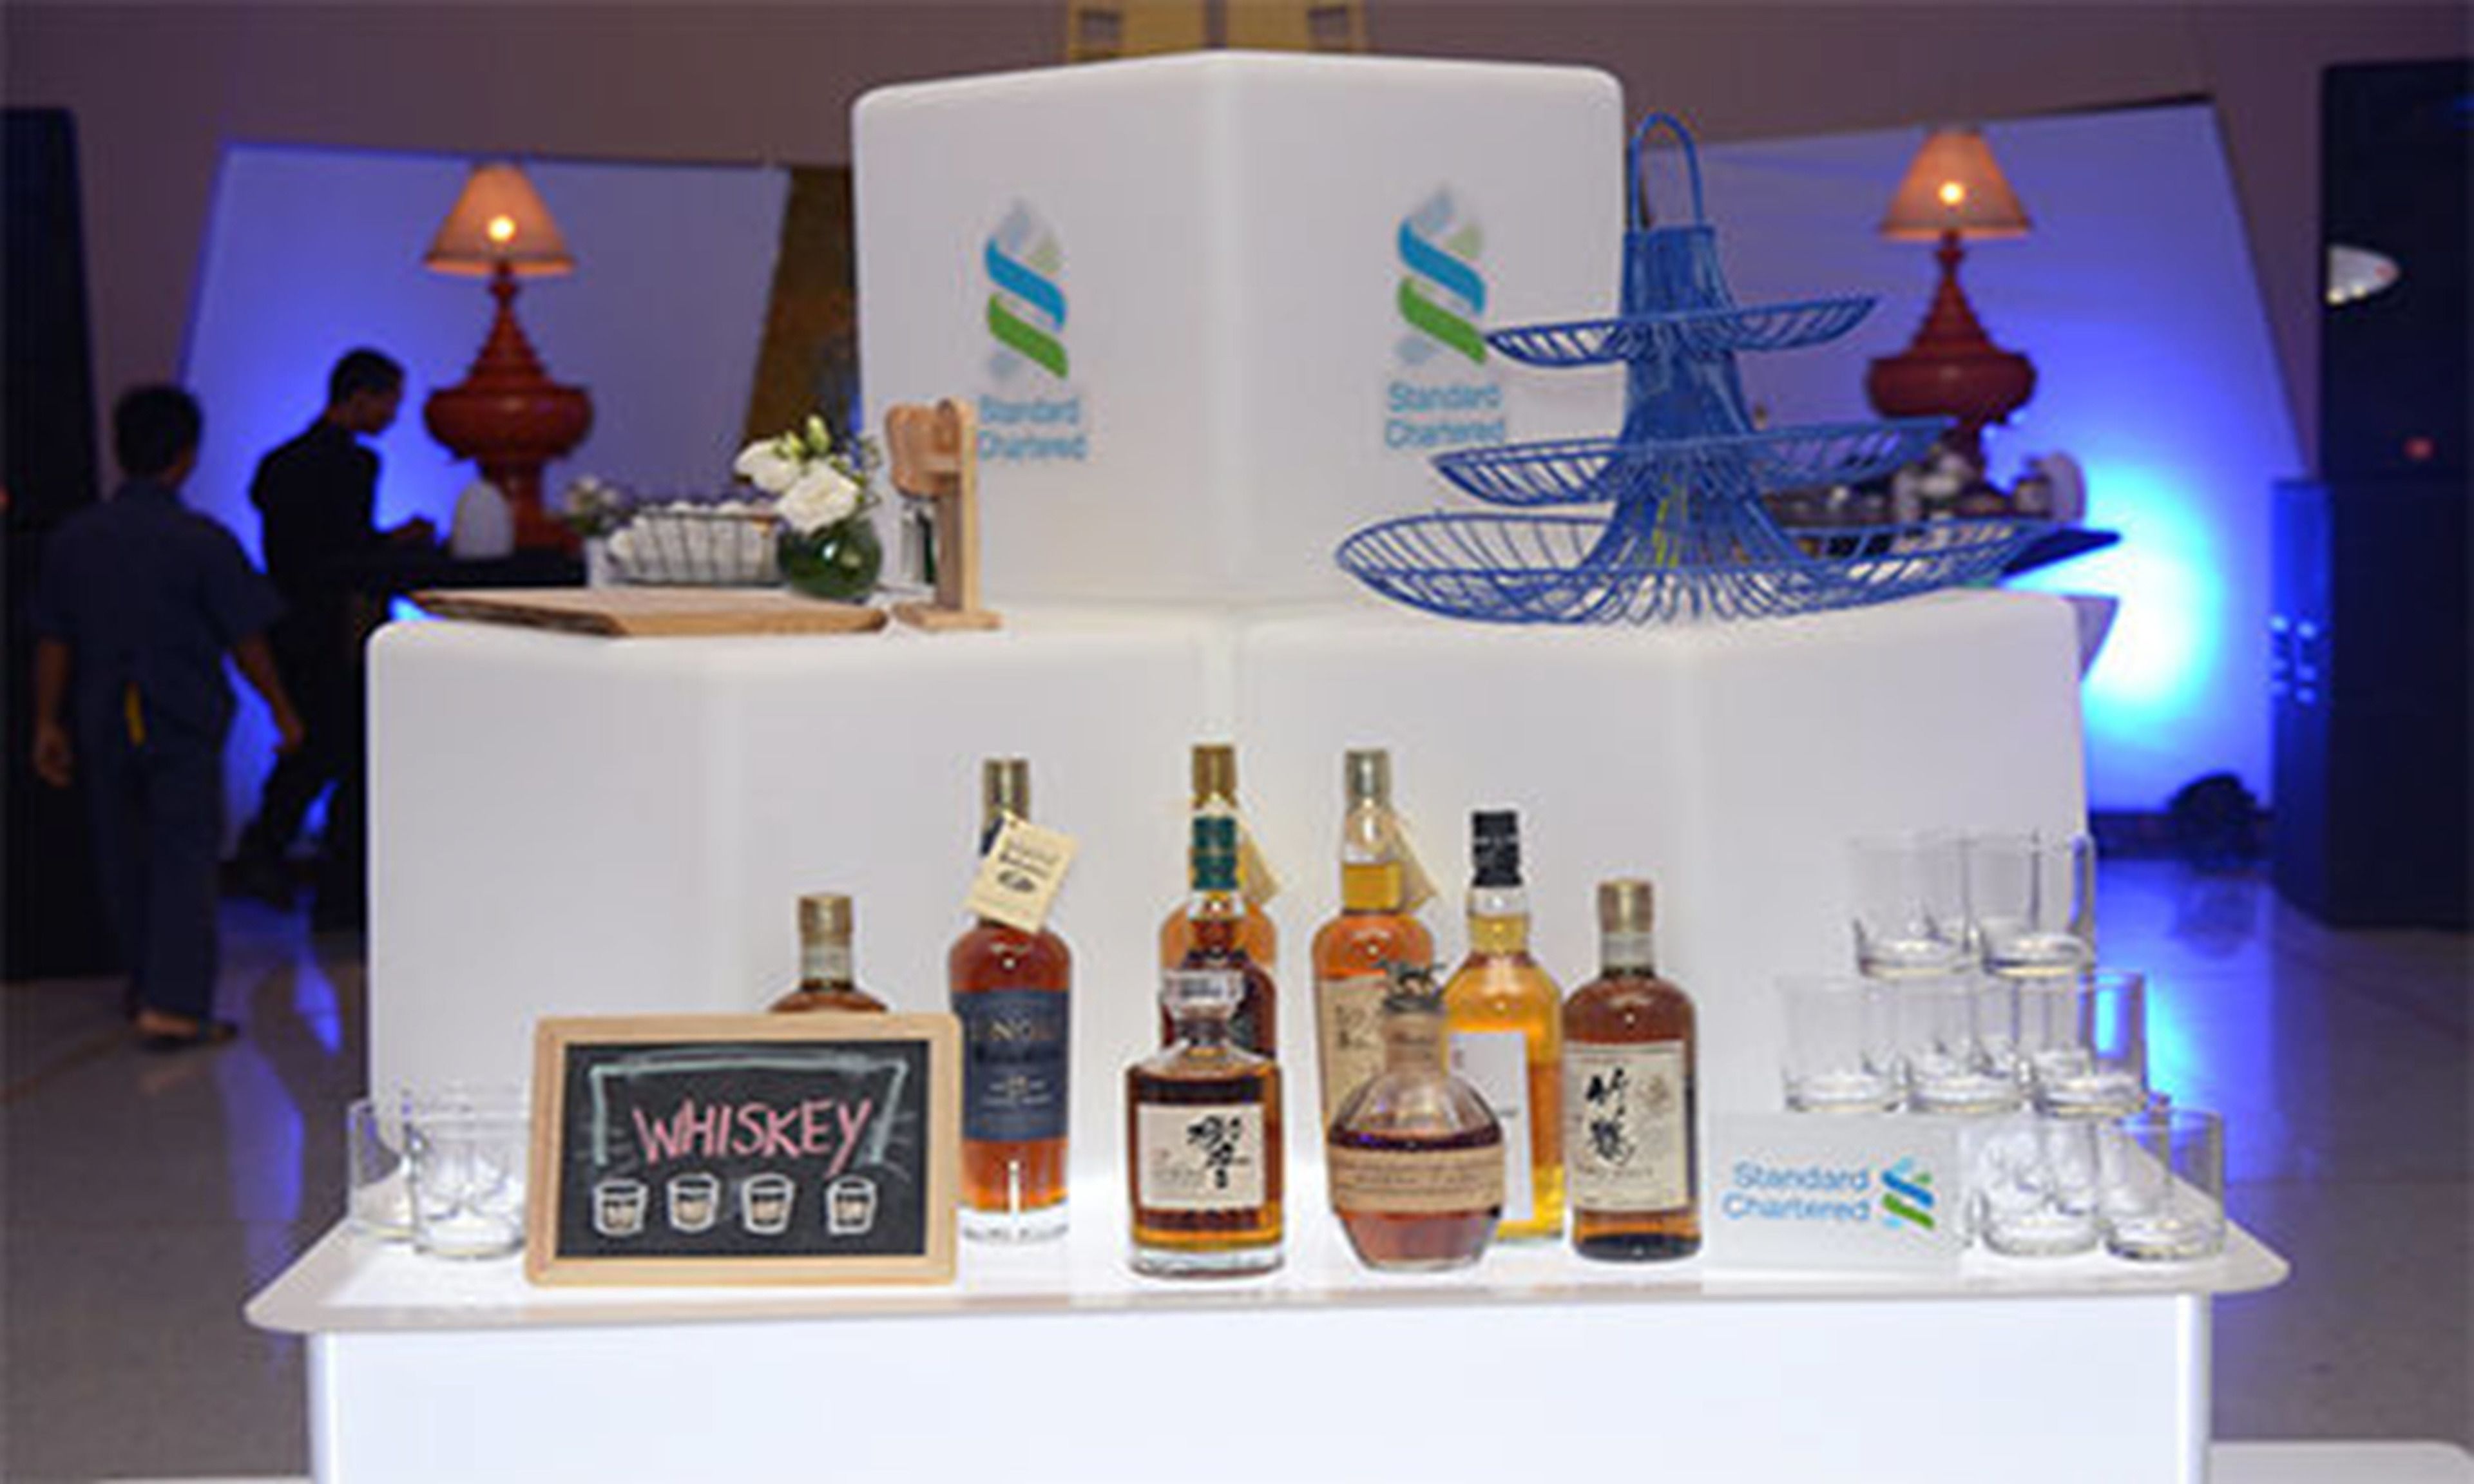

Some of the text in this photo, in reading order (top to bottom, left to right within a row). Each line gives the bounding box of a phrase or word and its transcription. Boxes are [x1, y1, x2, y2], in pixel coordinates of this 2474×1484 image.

[978, 394, 1080, 425] Standard
[1386, 381, 1501, 412] Standard
[1385, 419, 1506, 449] Chartered
[631, 1098, 872, 1177] WHISKEY
[1733, 1161, 1870, 1192] Standard
[1721, 1192, 1871, 1221] Chartered
